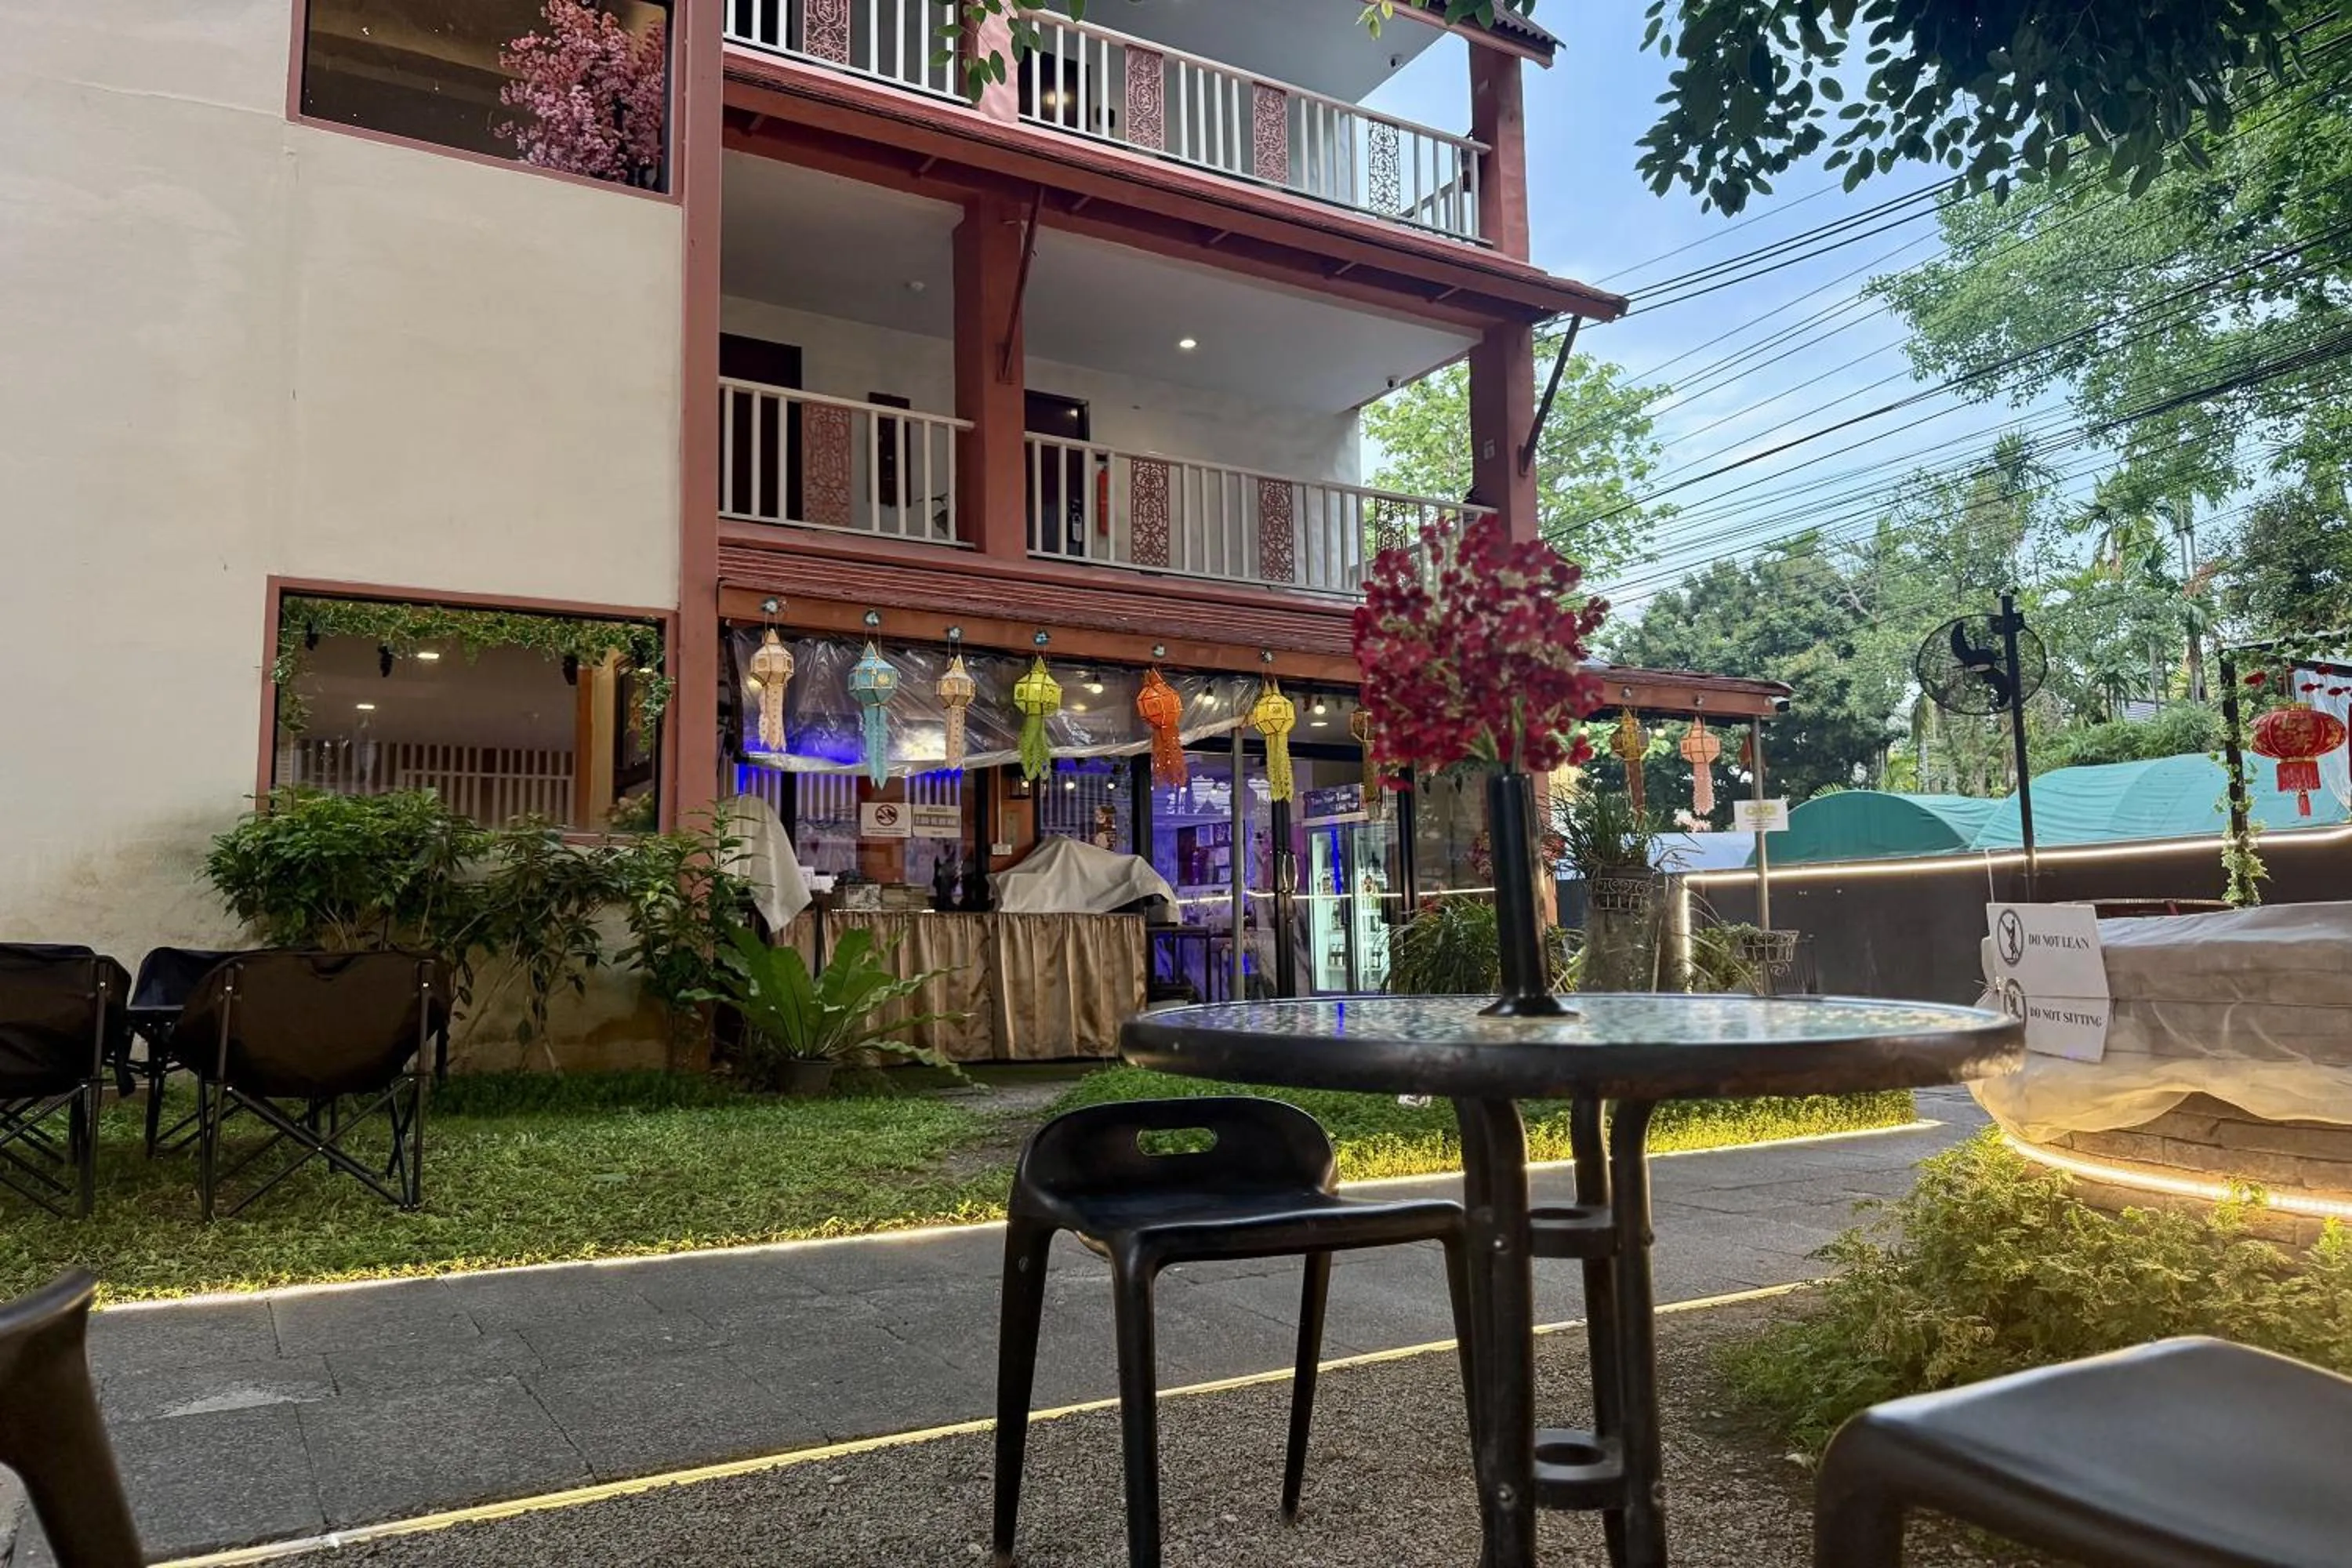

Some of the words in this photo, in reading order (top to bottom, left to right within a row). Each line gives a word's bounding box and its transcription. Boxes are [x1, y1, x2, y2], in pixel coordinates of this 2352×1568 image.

[2028, 934, 2041, 946] DO
[2042, 934, 2060, 948] NOT
[2061, 935, 2089, 949] LEAN
